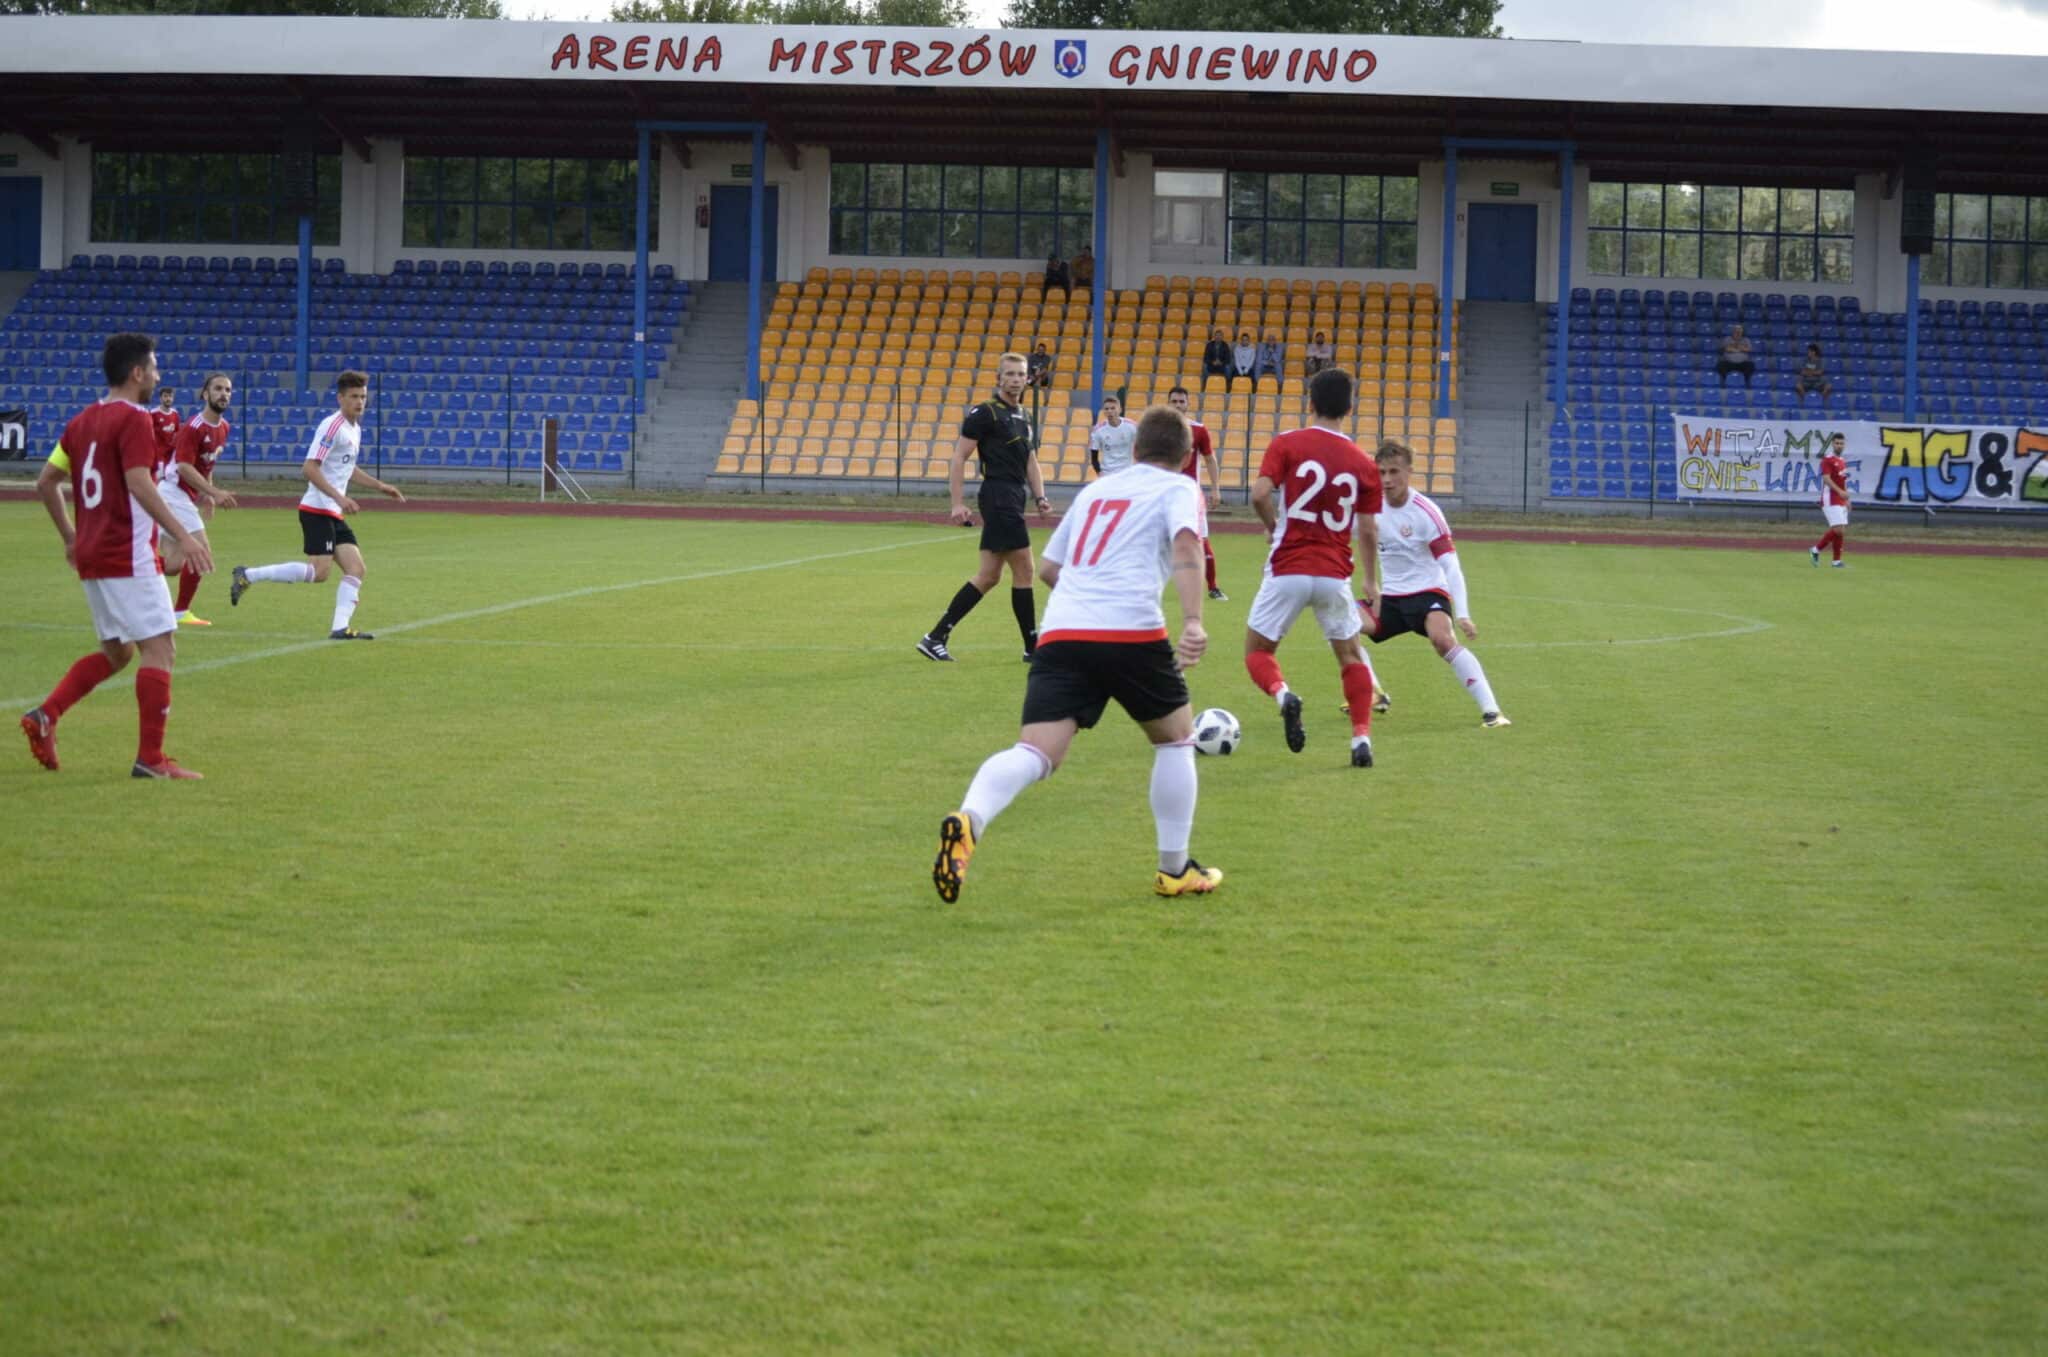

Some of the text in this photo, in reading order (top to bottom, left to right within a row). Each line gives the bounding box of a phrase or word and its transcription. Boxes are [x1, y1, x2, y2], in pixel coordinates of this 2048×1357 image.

[551, 33, 1377, 85] ARENA MISTRZÓW GNIEWINO
[81, 441, 103, 510] 6
[1682, 423, 1834, 459] WITAMY
[1287, 459, 1358, 532] 23
[1071, 498, 1132, 567] 17
